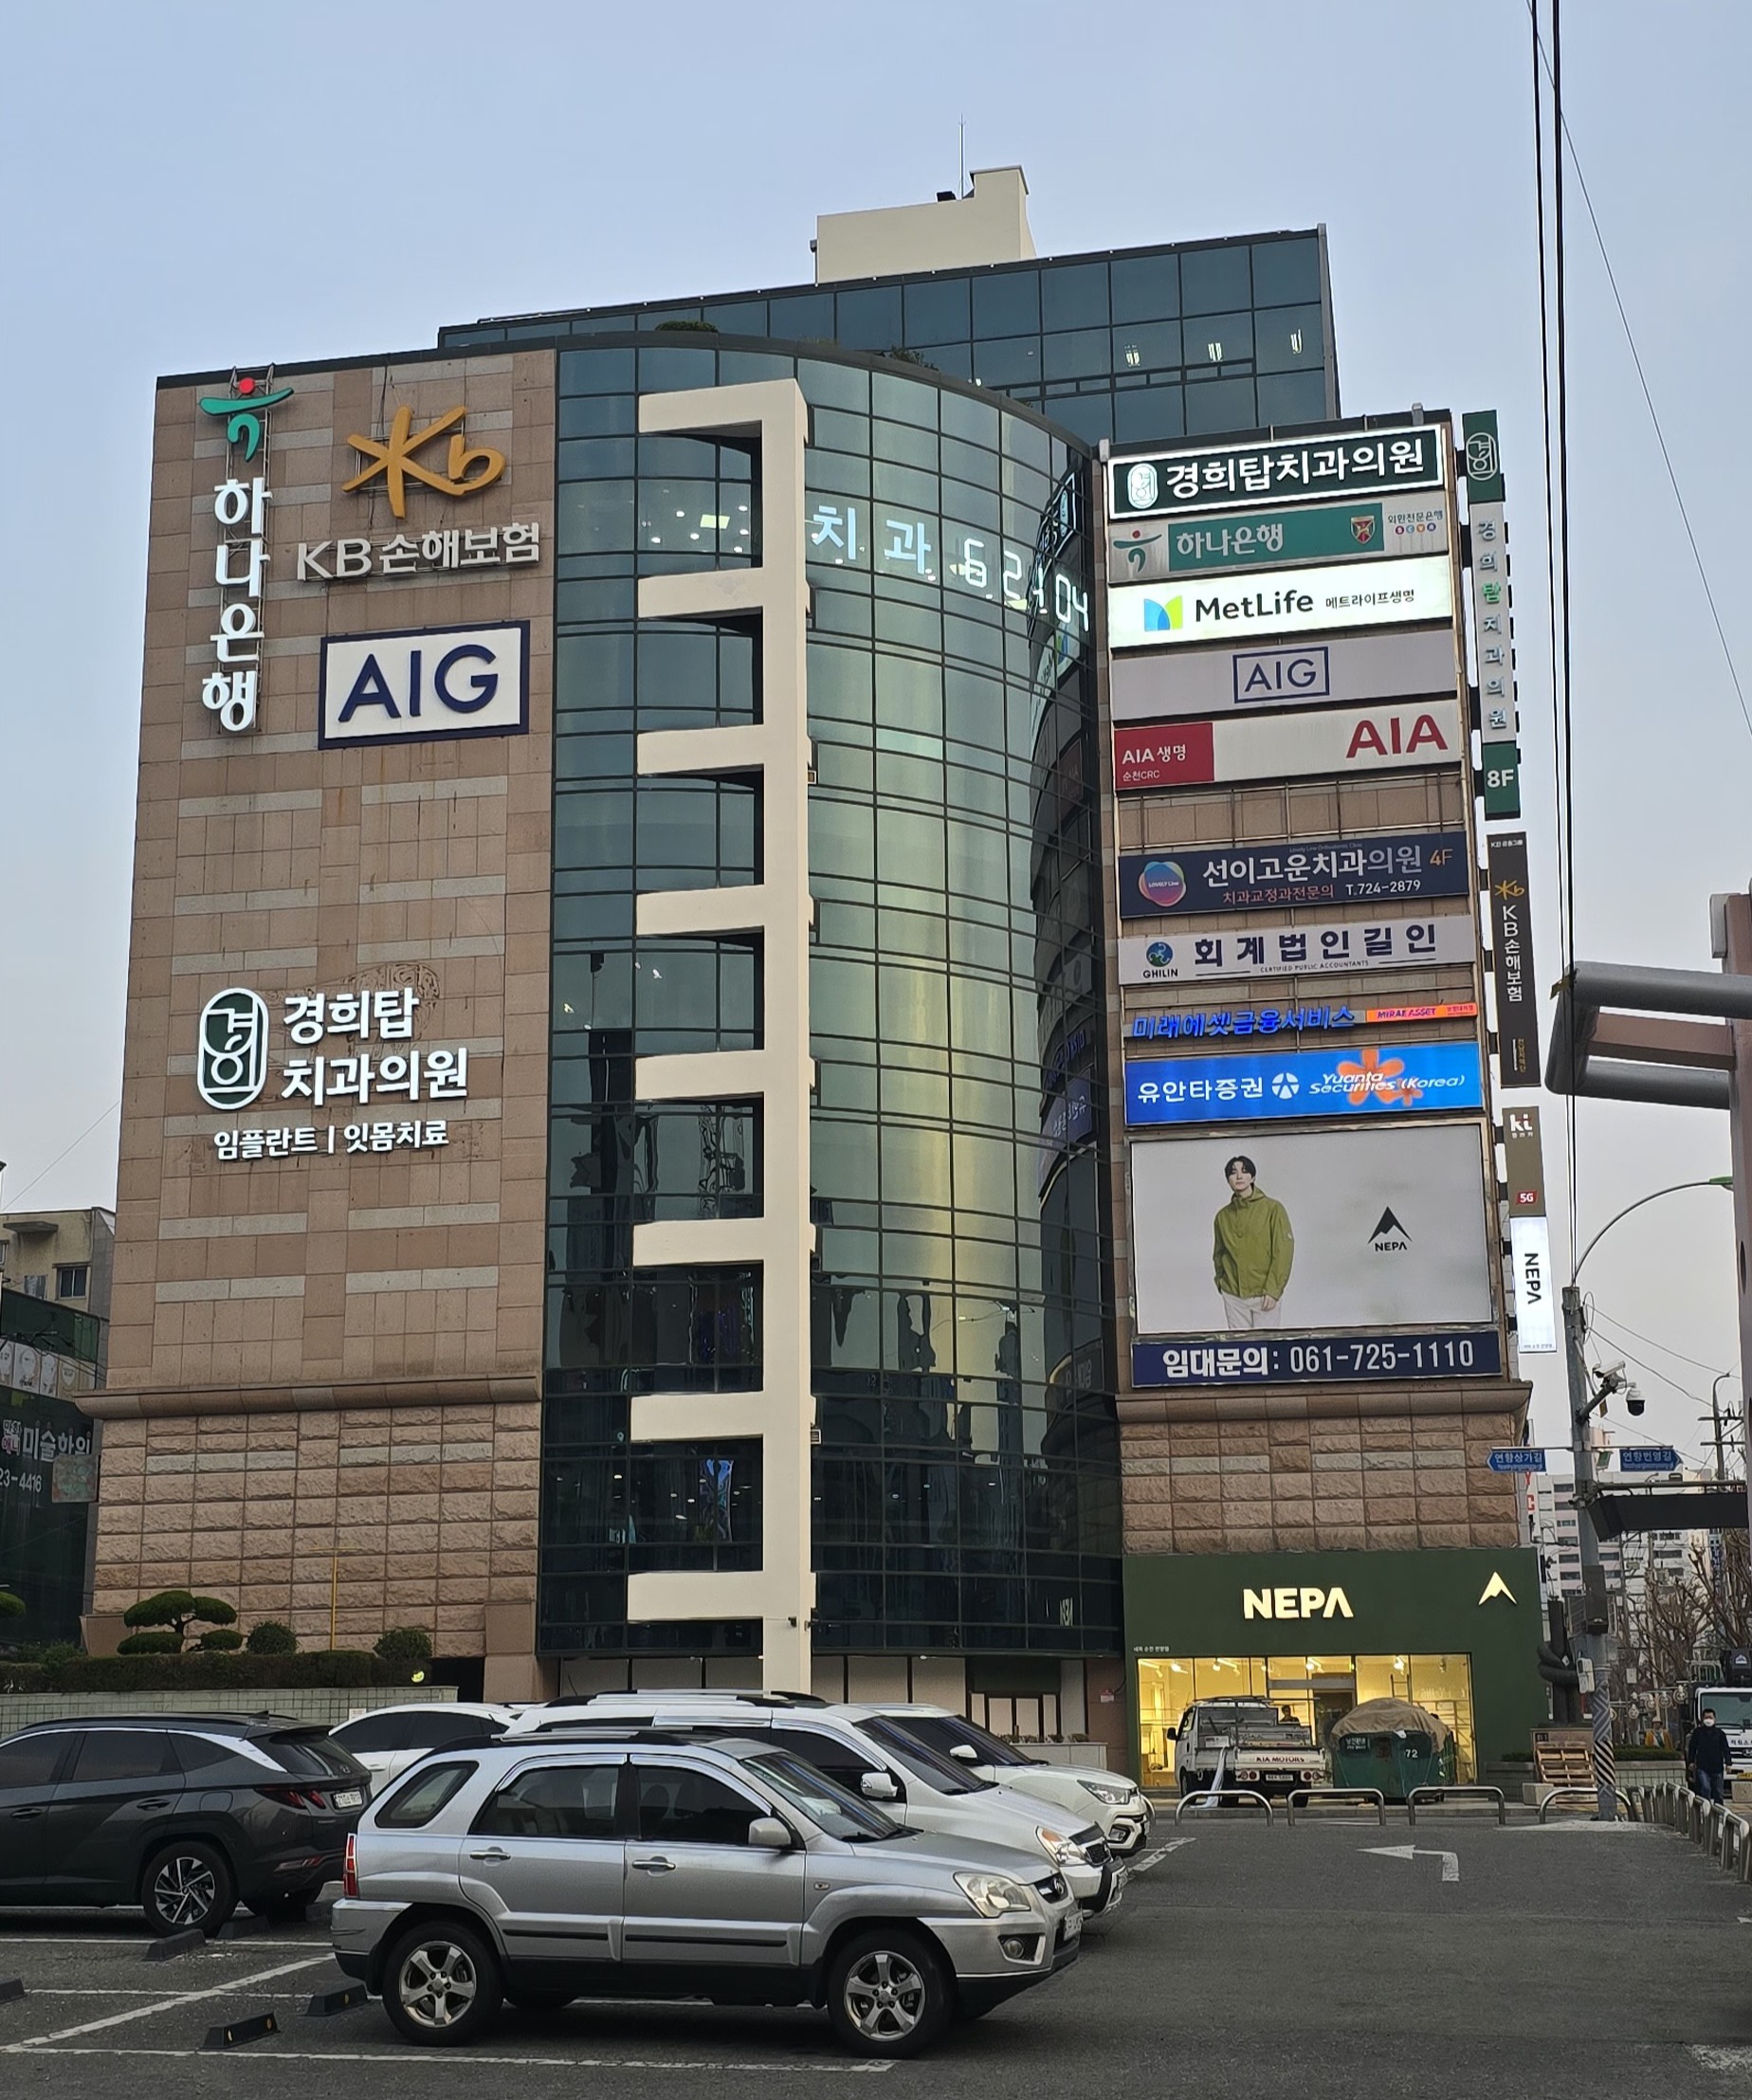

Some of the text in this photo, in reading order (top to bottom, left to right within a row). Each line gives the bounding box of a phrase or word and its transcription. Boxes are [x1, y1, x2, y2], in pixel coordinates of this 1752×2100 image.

[1166, 438, 1424, 500] 경희탑치과의원
[1176, 522, 1284, 560] 하나은행
[202, 477, 273, 732] 하나은행
[1195, 589, 1415, 622] MetLife 메트라이프생명
[338, 644, 499, 722] AIG
[1244, 658, 1317, 692] AIG
[1345, 714, 1449, 758] AIA
[1487, 769, 1514, 788] 8F
[1202, 845, 1453, 887] 선이고운치과의원 4F
[1223, 885, 1334, 904] 치과교정과전문의
[1345, 879, 1421, 897] T.724-2879
[1142, 968, 1178, 978] GHILIN
[1319, 960, 1369, 969] ACCOUNTANTS
[283, 987, 420, 1045] 경희탑
[1132, 1006, 1355, 1039] 미래에셋금융서비스
[1378, 1008, 1436, 1018] MIRAE ASSET
[281, 1047, 468, 1106] 치과의원
[1138, 1076, 1263, 1104] 유안타증권
[1308, 1075, 1466, 1094] Securities (Korea)
[1323, 1071, 1383, 1085] Yuanta
[213, 1120, 449, 1161] 임플란트 잇몸치료
[1520, 1193, 1534, 1202] 5G
[1375, 1241, 1408, 1252] NEPA
[1524, 1252, 1542, 1305] NEPA
[1289, 1340, 1474, 1373] 061-725-1110
[1494, 1452, 1542, 1463] 연향상가길
[1244, 1587, 1354, 1619] NEPA
[1405, 1748, 1418, 1758] 72
